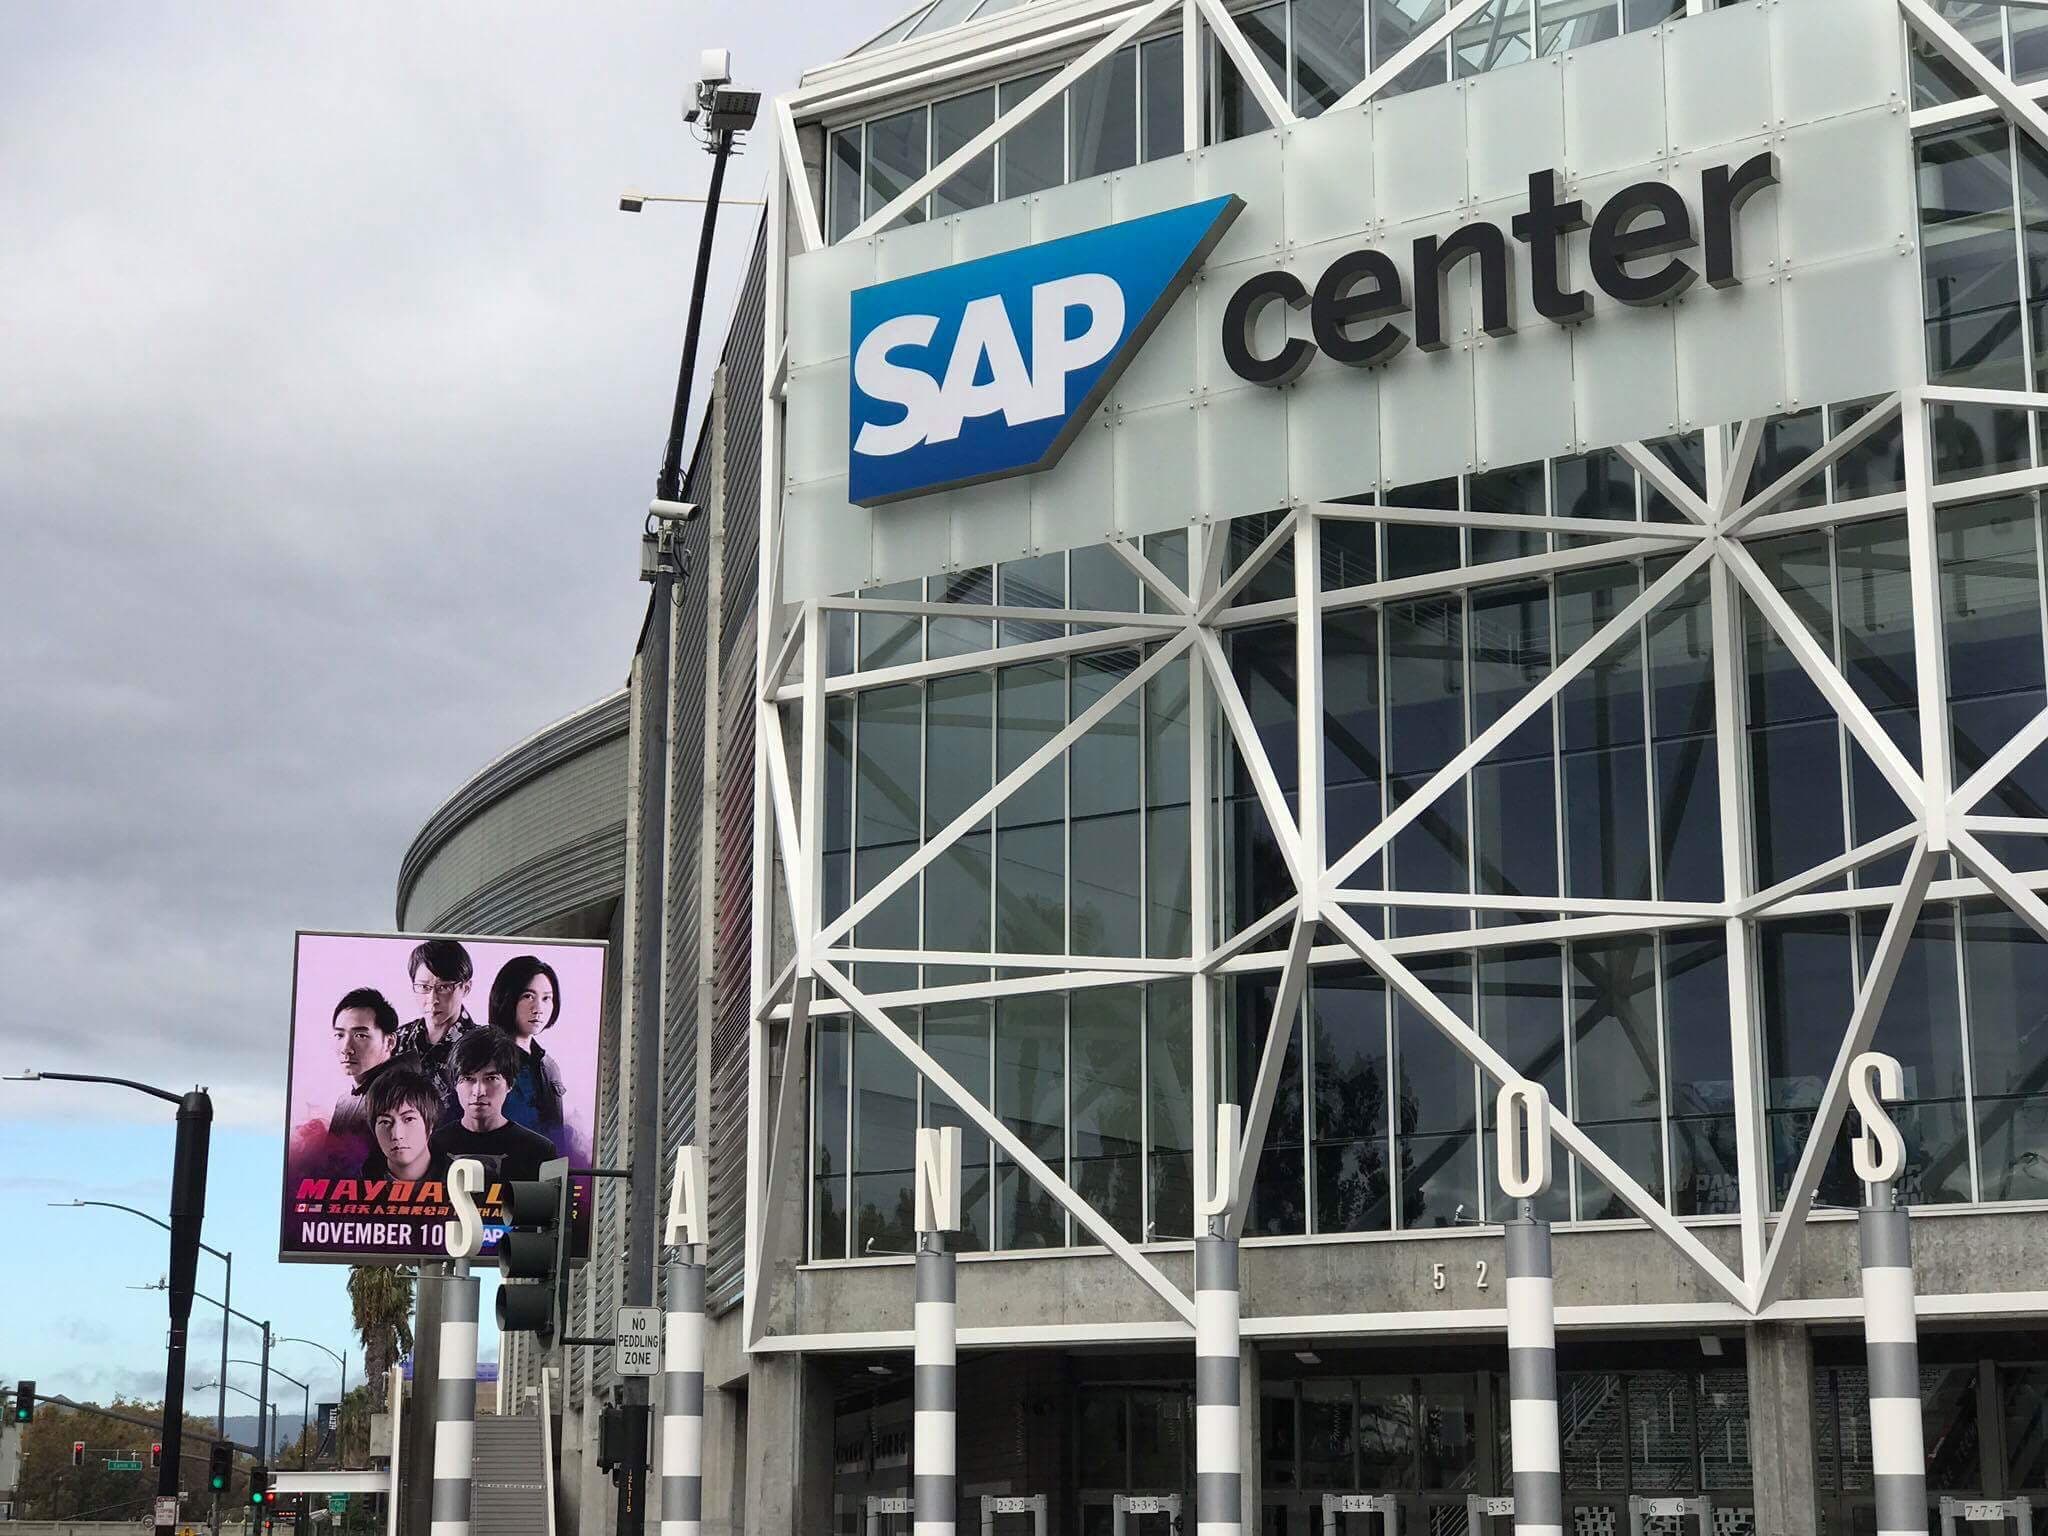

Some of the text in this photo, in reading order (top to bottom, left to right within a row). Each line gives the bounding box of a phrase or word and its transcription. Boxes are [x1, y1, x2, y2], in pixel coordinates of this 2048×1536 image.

[853, 151, 1780, 457] SAP center
[296, 1179, 444, 1202] MAYDA
[301, 1221, 444, 1245] NOVEMBER 10
[632, 1317, 646, 1331] NO
[618, 1334, 659, 1348] PEDDLING
[624, 1351, 651, 1365] ZONE
